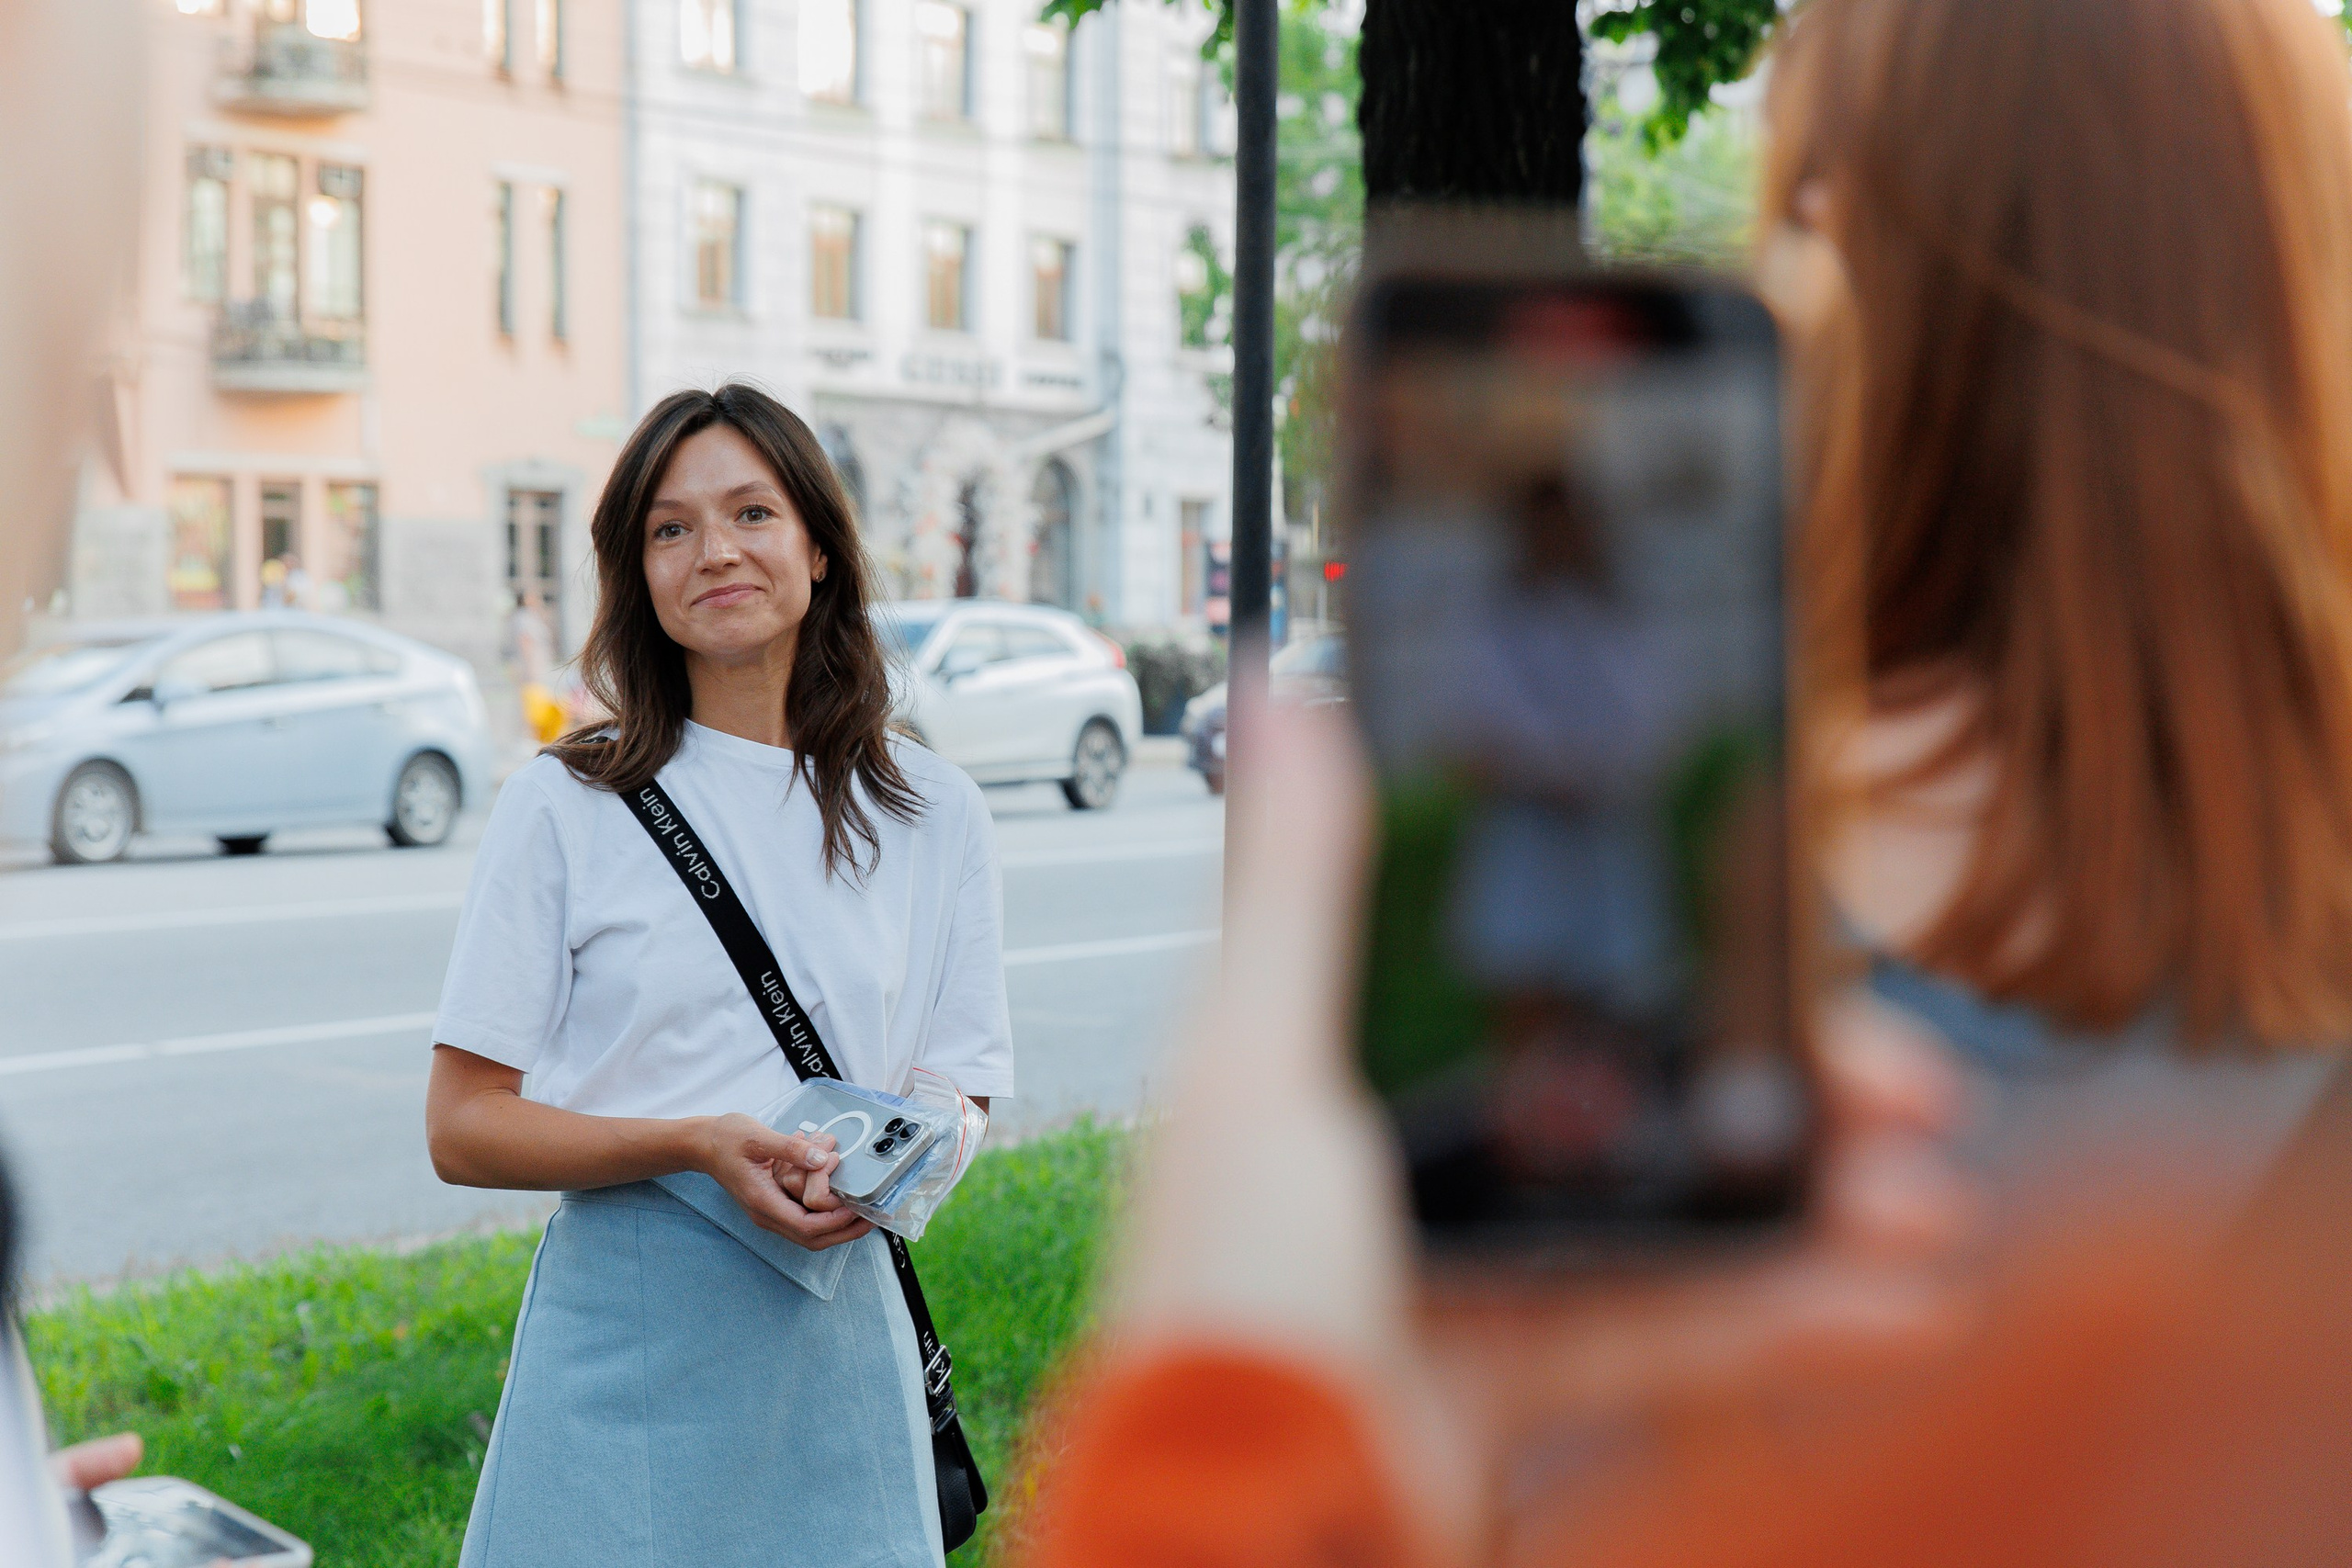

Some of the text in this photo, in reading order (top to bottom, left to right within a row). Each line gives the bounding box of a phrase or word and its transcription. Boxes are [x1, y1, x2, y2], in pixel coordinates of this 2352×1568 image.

[639, 787, 720, 899] Calvin Klein
[761, 970, 831, 1078] alvin Klein
